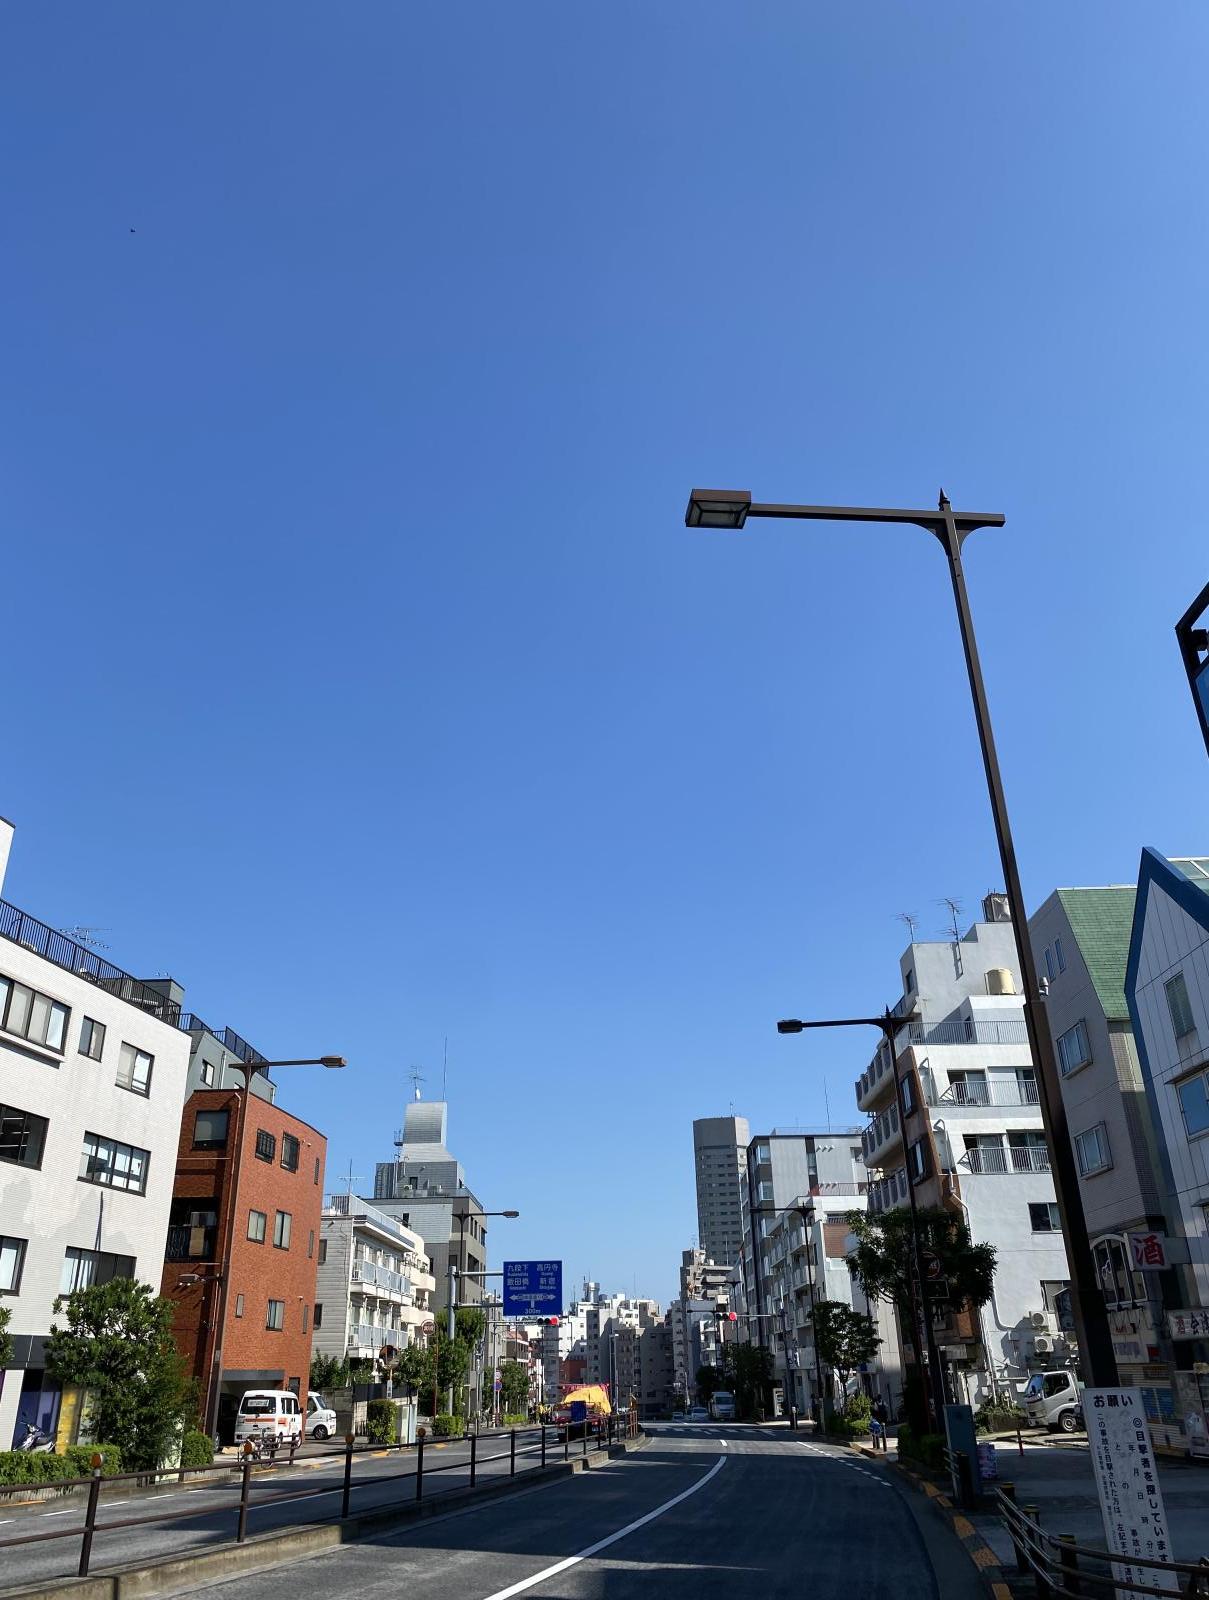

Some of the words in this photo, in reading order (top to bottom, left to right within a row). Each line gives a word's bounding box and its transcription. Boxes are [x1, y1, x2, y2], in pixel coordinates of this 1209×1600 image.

[1133, 1235, 1164, 1266] 酒
[1093, 1394, 1133, 1408] お願い
[1121, 1481, 1129, 1490] の
[1137, 1491, 1144, 1500] 日
